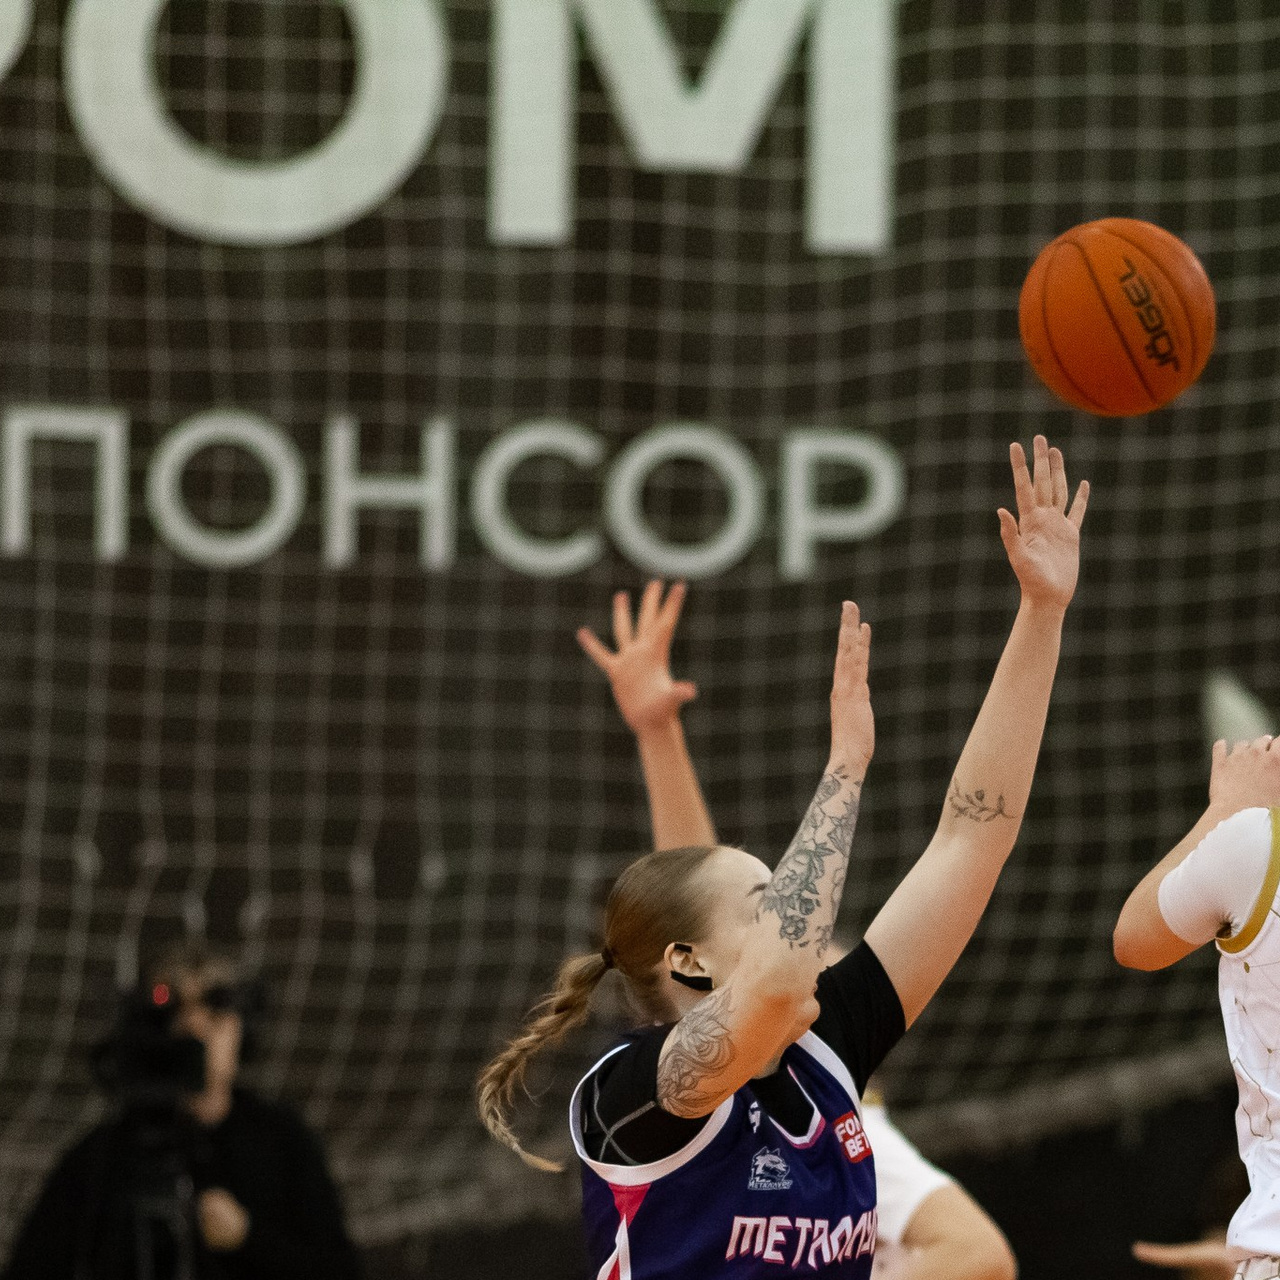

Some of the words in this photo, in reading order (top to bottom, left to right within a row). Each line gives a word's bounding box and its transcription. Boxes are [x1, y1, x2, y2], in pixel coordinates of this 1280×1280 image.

[0, 0, 897, 256] ОМ
[2, 405, 907, 580] ПОНСОР
[725, 1208, 877, 1271] МЕТАЛЛУ
